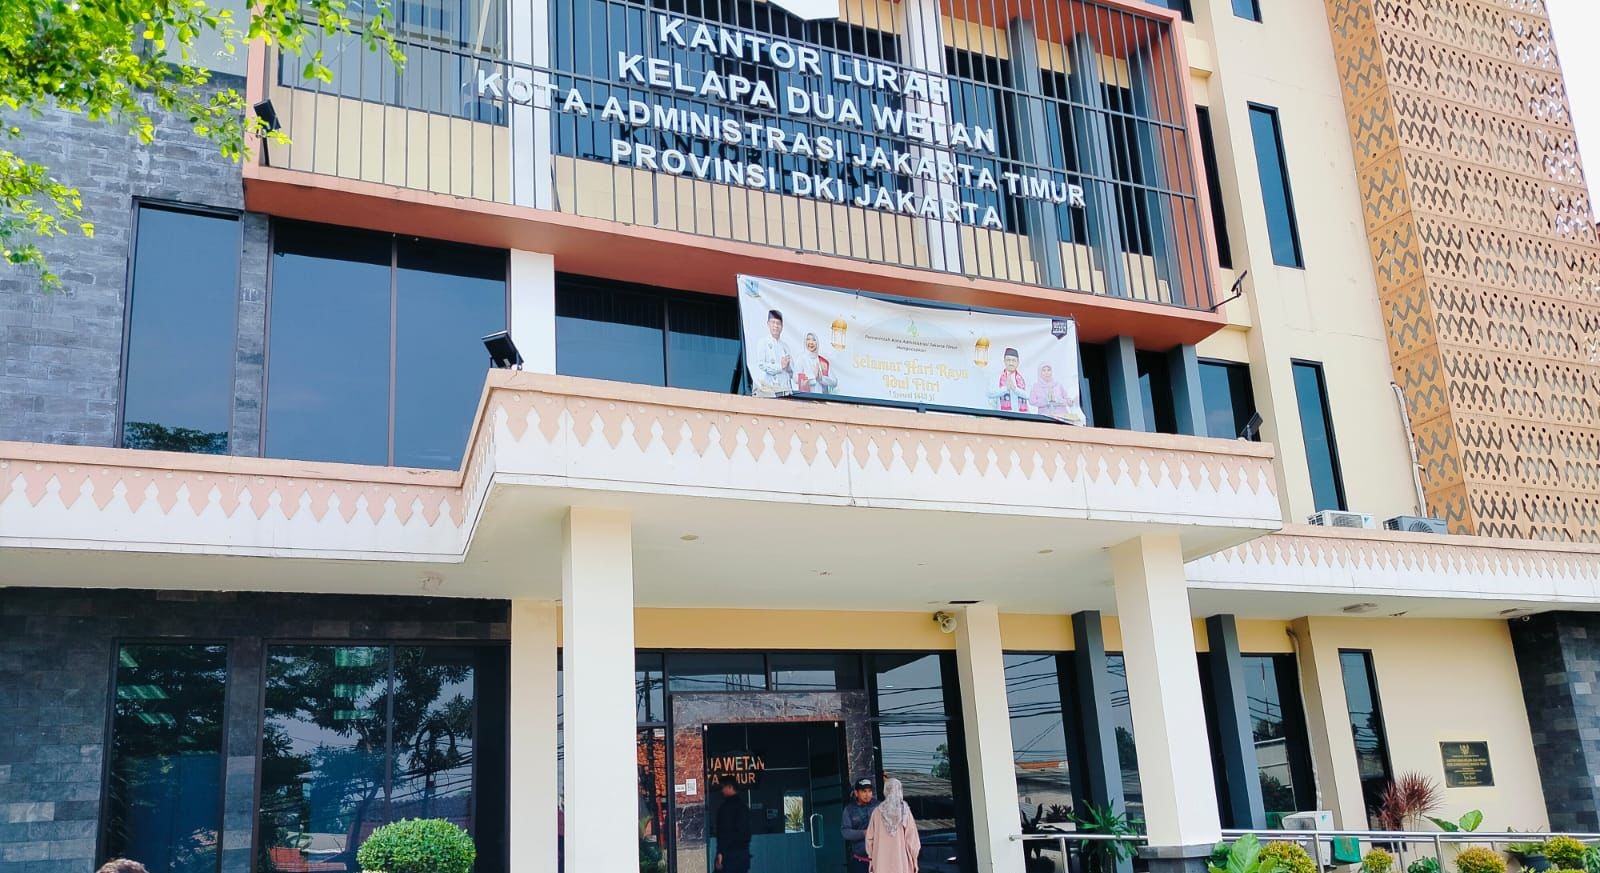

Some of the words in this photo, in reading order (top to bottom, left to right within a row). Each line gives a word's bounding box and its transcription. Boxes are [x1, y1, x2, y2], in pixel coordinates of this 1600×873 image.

[618, 51, 777, 110] KELAPA
[787, 85, 863, 127] DUA
[871, 103, 996, 154] WETAN
[659, 14, 823, 77] KANTOR
[833, 53, 950, 104] LURAH
[477, 69, 589, 116] KOTA
[601, 96, 844, 163] ADMINISTRASI
[852, 142, 998, 192] JAKARTA
[1002, 170, 1087, 209] TIMUR
[611, 138, 776, 192] PROVINSI
[791, 171, 845, 203] DKI
[855, 183, 1003, 230] JAKARTA
[852, 353, 902, 372] Selamat
[904, 358, 933, 376] Hari
[936, 363, 969, 381] Raya
